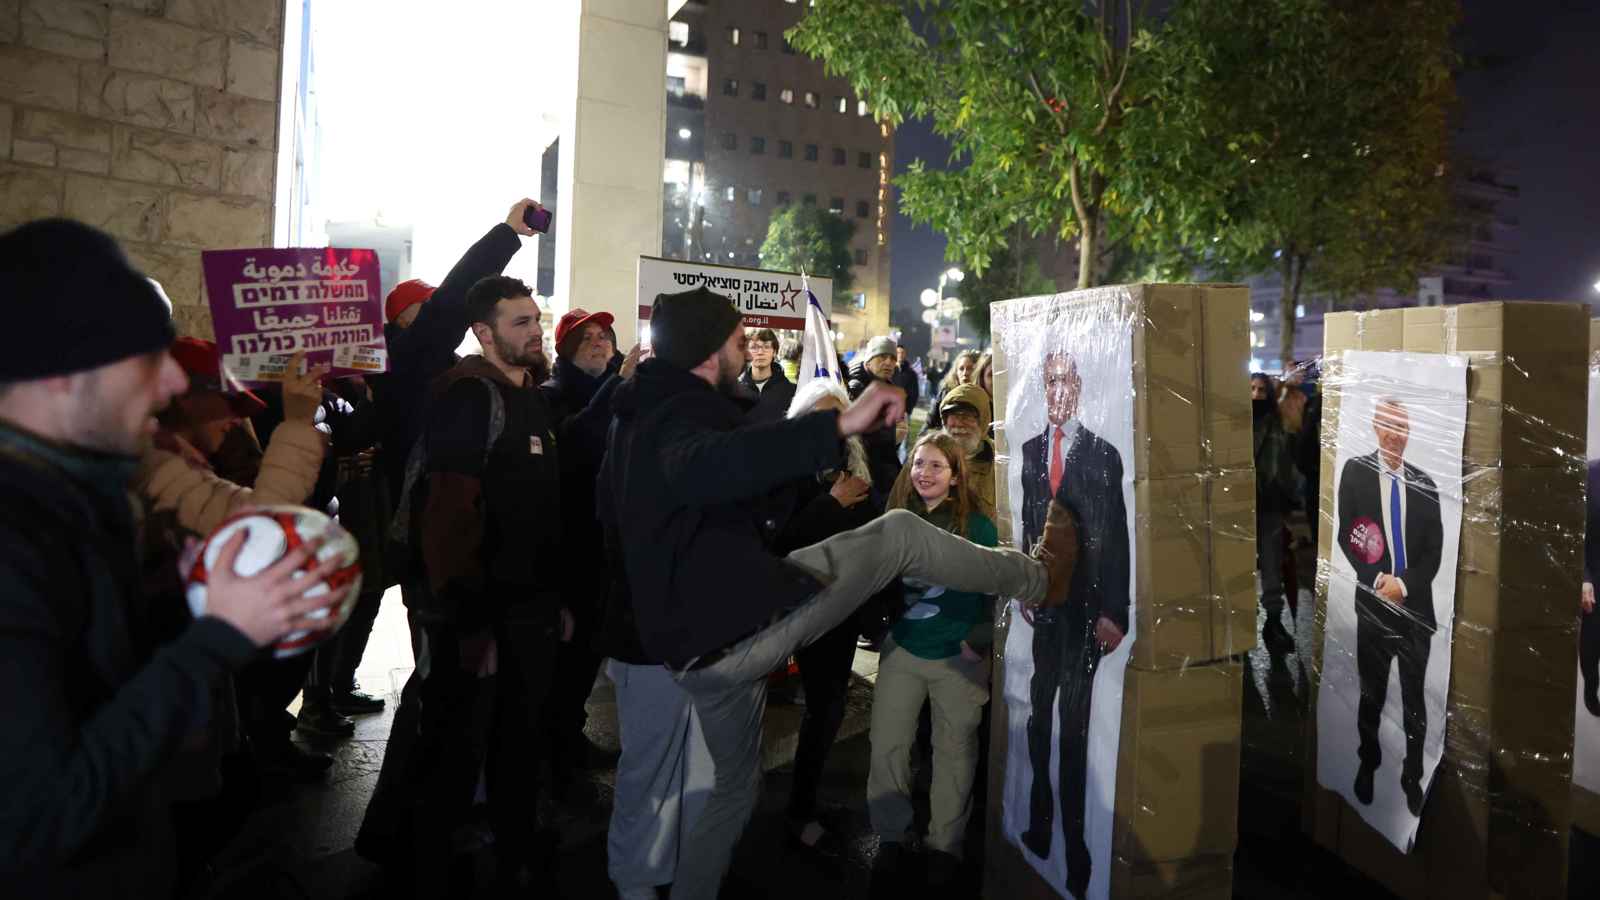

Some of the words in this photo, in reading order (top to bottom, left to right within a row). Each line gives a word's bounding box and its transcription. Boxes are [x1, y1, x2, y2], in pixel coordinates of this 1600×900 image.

[243, 257, 307, 283] دموية
[311, 256, 360, 280] حكومة
[306, 280, 365, 299] ממשלת
[673, 272, 740, 290] סוציאליסטי
[744, 280, 778, 293] מאבק
[241, 284, 301, 303] דמים
[746, 294, 777, 310] نضال
[237, 333, 297, 355] כולנו
[301, 333, 328, 349] את
[330, 328, 370, 345] הורגת
